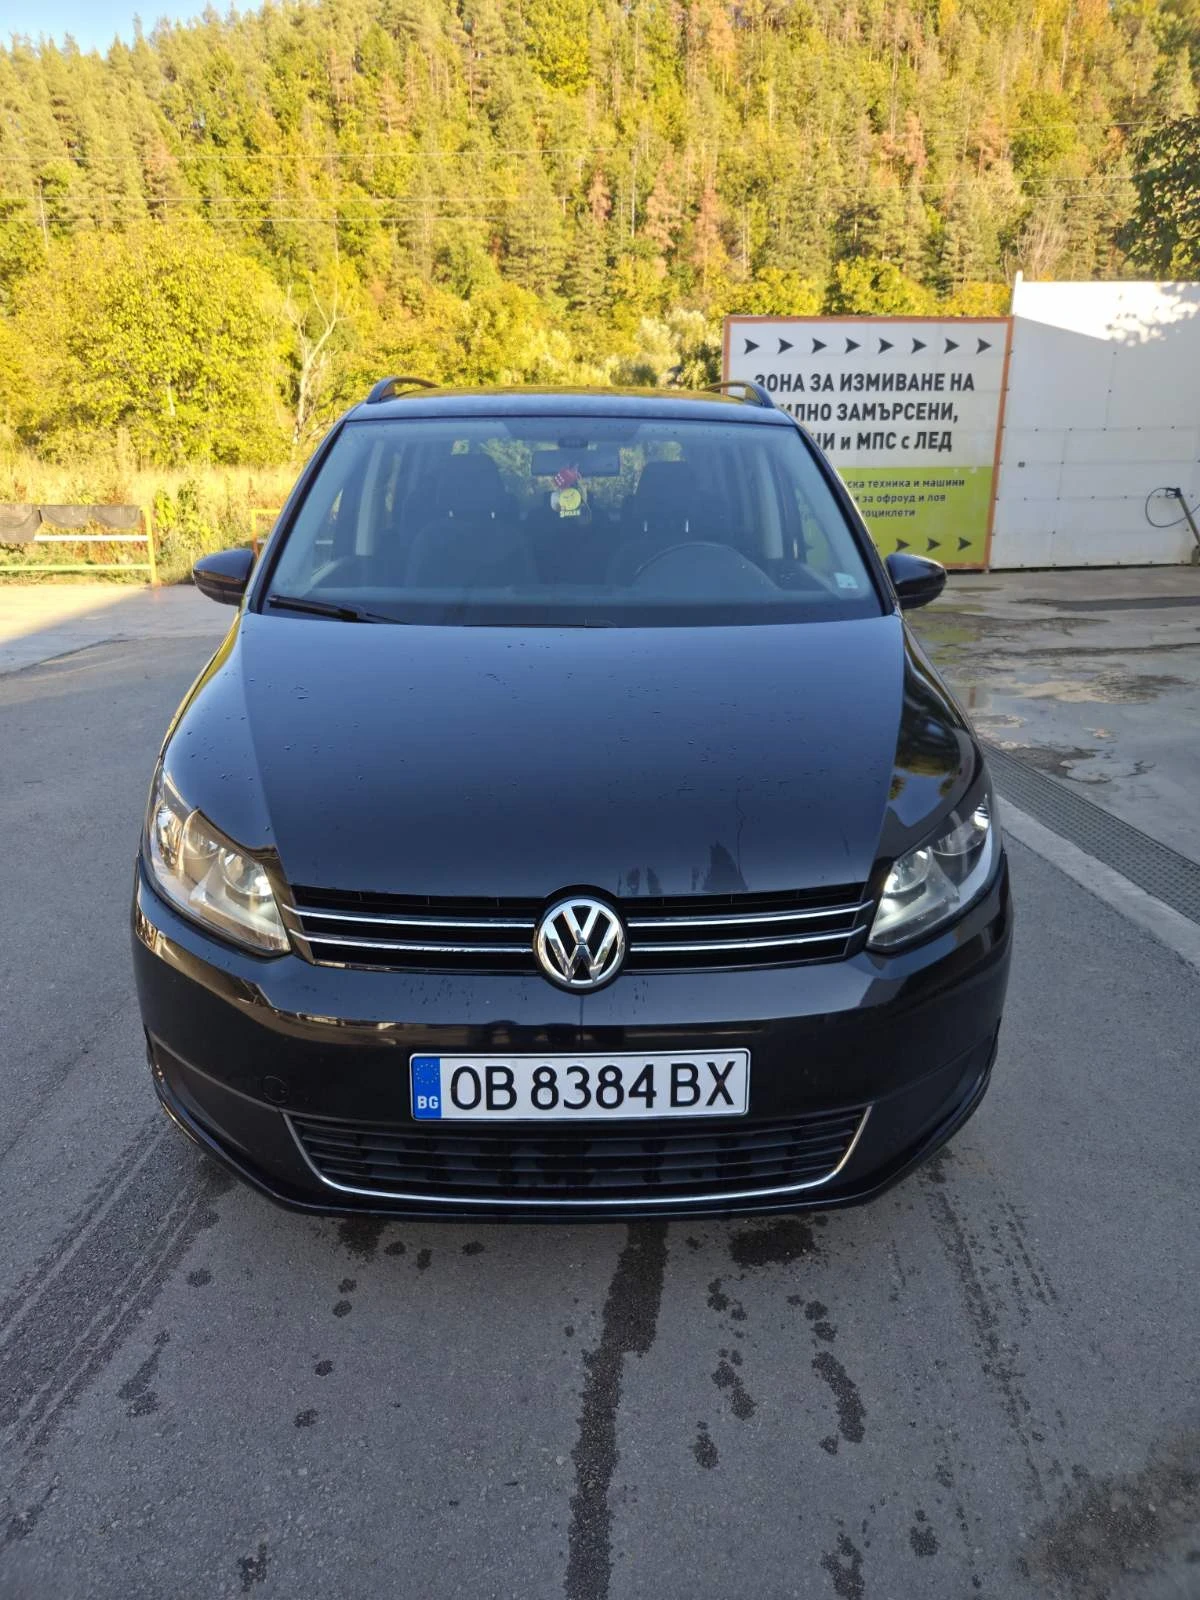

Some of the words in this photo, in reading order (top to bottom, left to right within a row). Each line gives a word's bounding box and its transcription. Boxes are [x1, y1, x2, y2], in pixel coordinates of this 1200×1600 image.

[754, 373, 805, 392] ЗОНА
[810, 373, 834, 392] ЗА
[840, 373, 945, 391] ИЗМИВАНЕ
[950, 373, 974, 391] НА
[836, 402, 958, 424] ЗАМЪРСЕНИ,
[857, 432, 897, 450] МПС
[914, 431, 952, 452] ЛЕД
[868, 479, 911, 489] техника
[923, 479, 965, 488] машини
[877, 494, 915, 504] офроуд
[416, 1095, 439, 1110] BG
[450, 1065, 518, 1111] OB
[530, 1063, 657, 1110] 8384
[670, 1060, 736, 1108] BX
